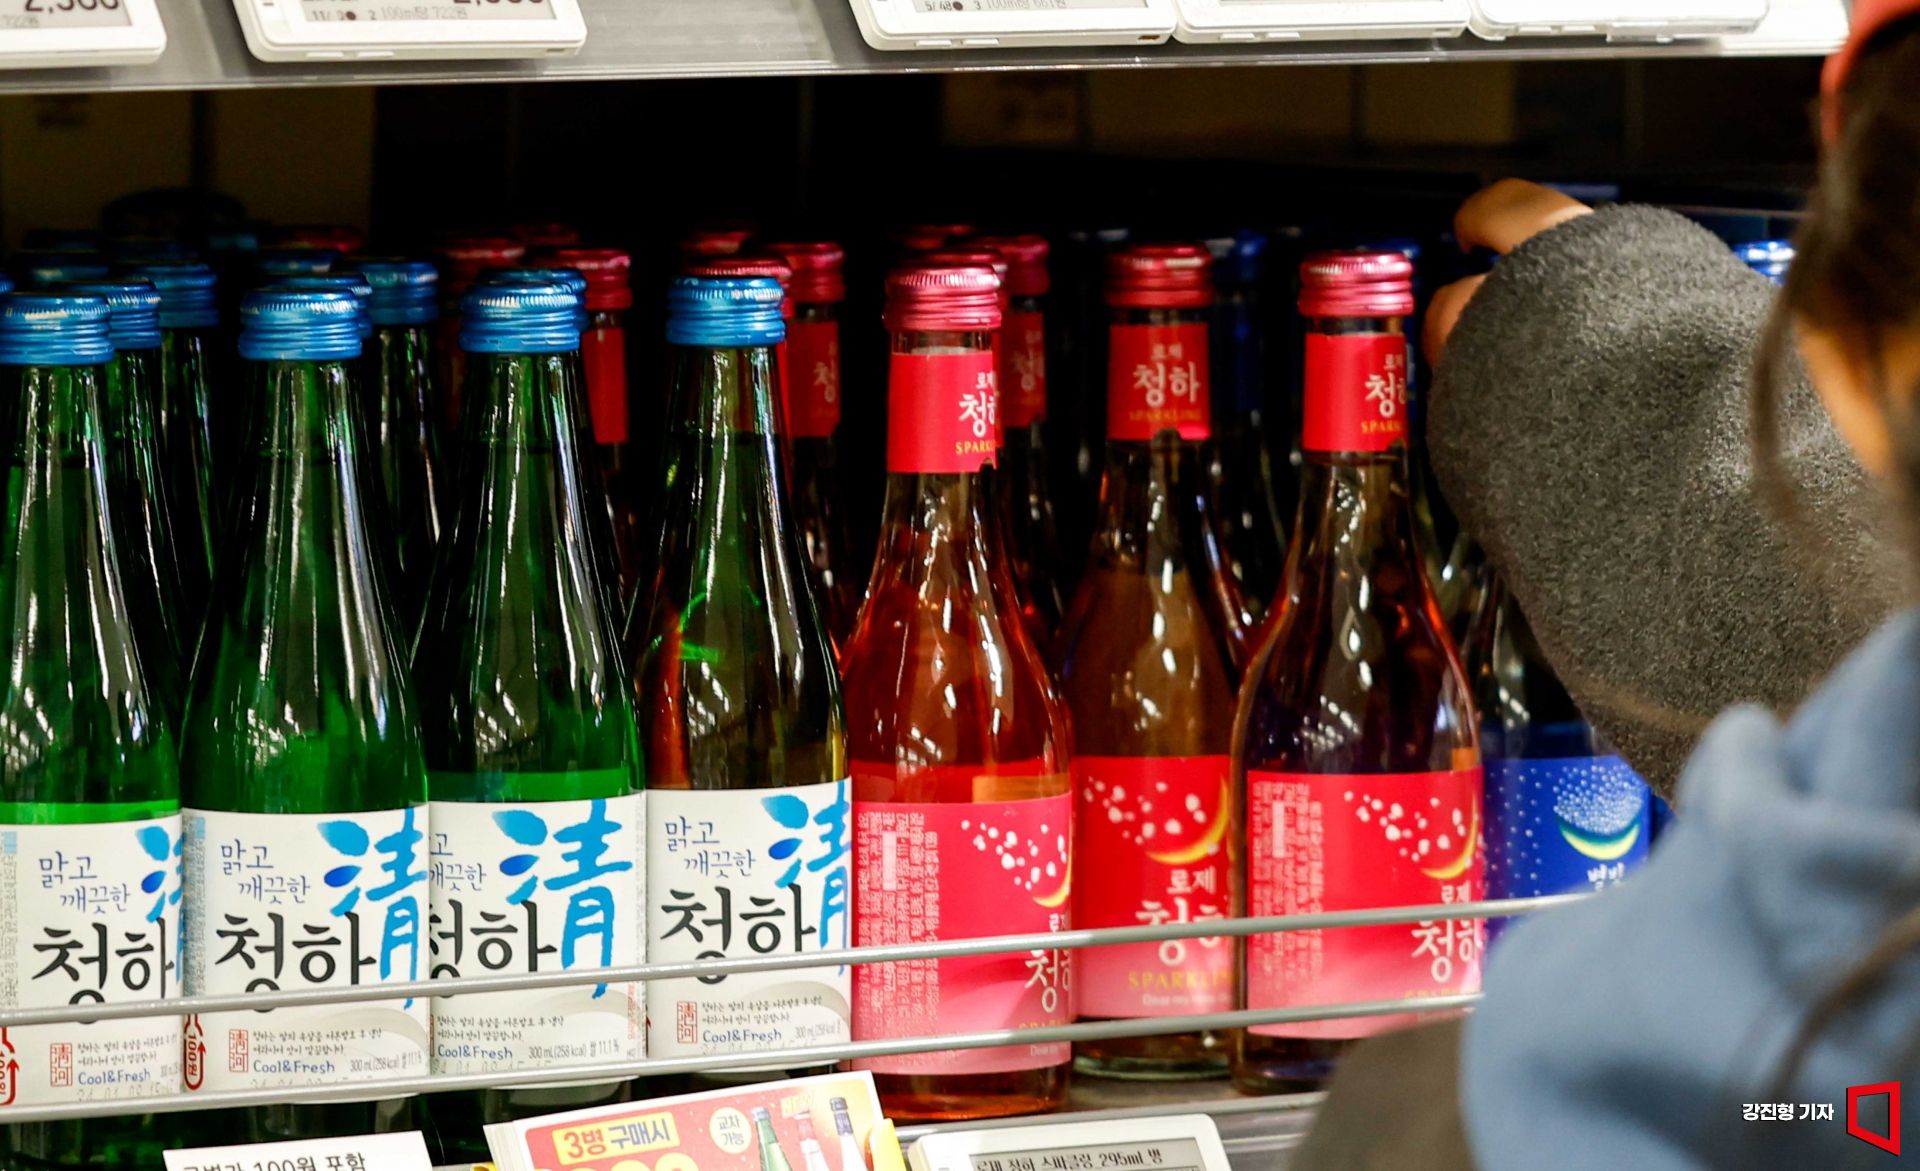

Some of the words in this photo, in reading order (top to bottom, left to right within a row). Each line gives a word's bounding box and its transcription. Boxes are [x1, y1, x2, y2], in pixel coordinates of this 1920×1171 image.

[1133, 361, 1200, 408] 청하
[429, 834, 453, 856] 고
[665, 816, 720, 852] 맑고
[39, 851, 97, 888] 맑고
[221, 839, 274, 875] 맑고
[684, 849, 756, 879] 깨끗한
[238, 875, 311, 904] 깨끗한
[1166, 865, 1216, 894] 로제
[60, 883, 131, 914] 깨끗한
[660, 883, 816, 984] 청하
[32, 917, 175, 1024] 청하
[215, 912, 377, 1012] 청하
[702, 1028, 782, 1044] Cool&Fresh
[253, 1059, 335, 1074] Cool&Fresh
[437, 1043, 513, 1060] Cool&Fresh
[78, 1067, 151, 1085] Cool&Fresh
[717, 1115, 740, 1131] 교차
[563, 1131, 607, 1159] 3병
[608, 1118, 671, 1149] 구매시
[722, 1131, 745, 1147] 가능
